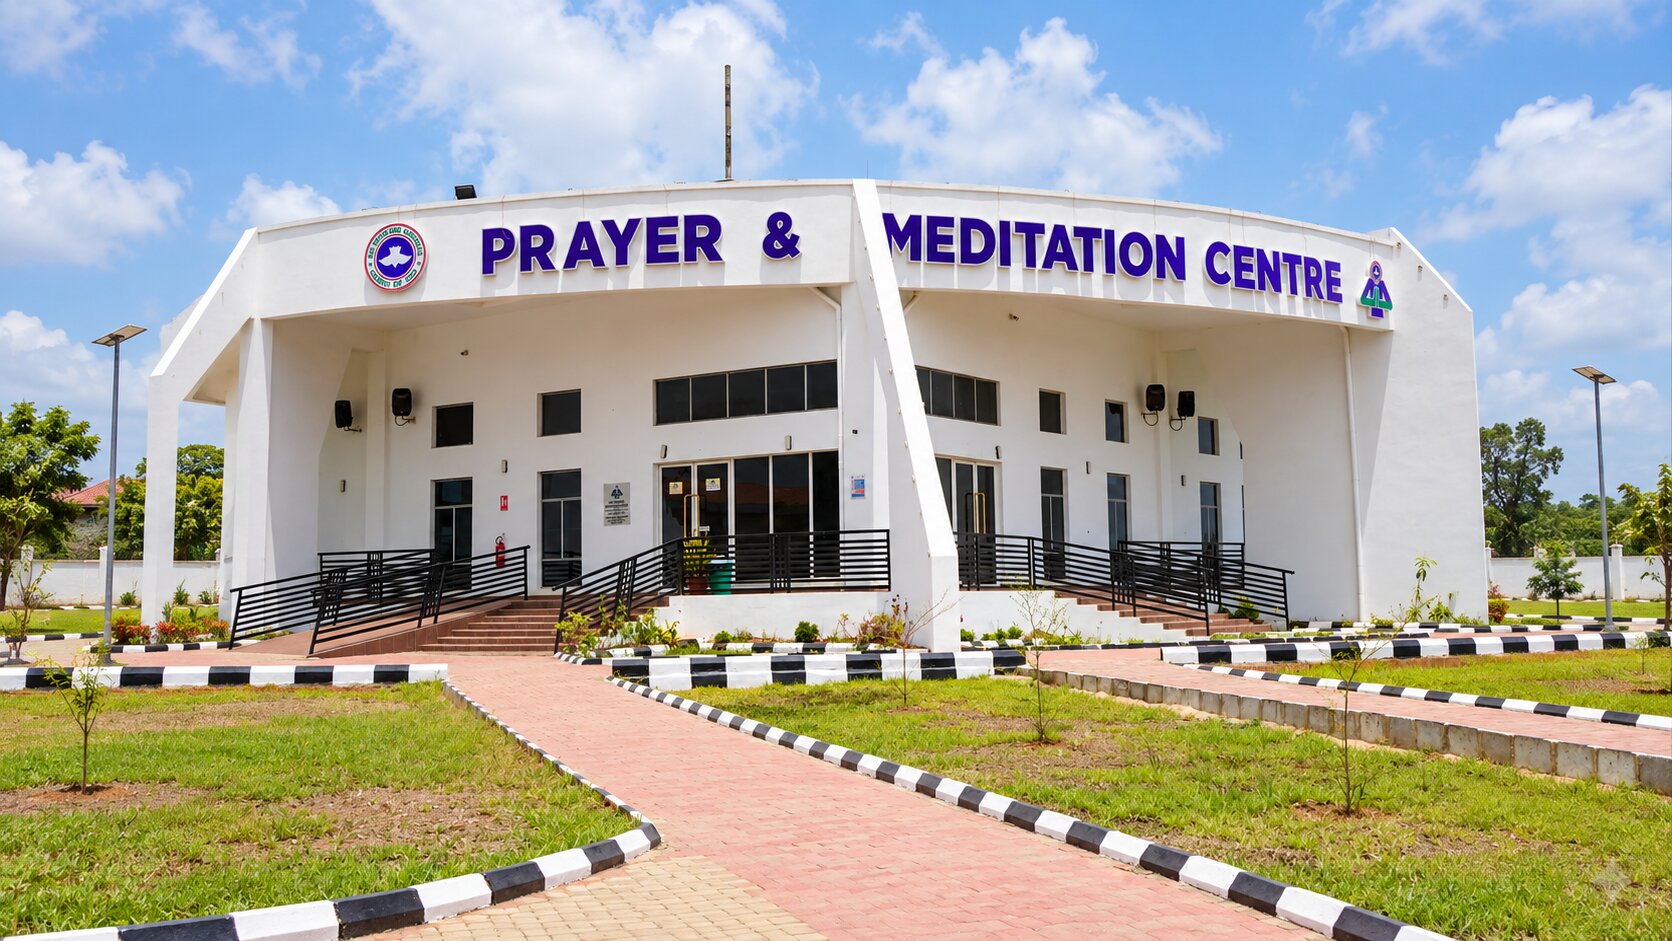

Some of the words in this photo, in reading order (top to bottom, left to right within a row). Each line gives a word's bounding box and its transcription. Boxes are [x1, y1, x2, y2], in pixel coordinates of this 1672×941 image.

[482, 214, 722, 275] PRAYER
[762, 211, 801, 260] &
[881, 212, 1186, 282] MEDITATION
[1205, 241, 1343, 304] CENTRE
